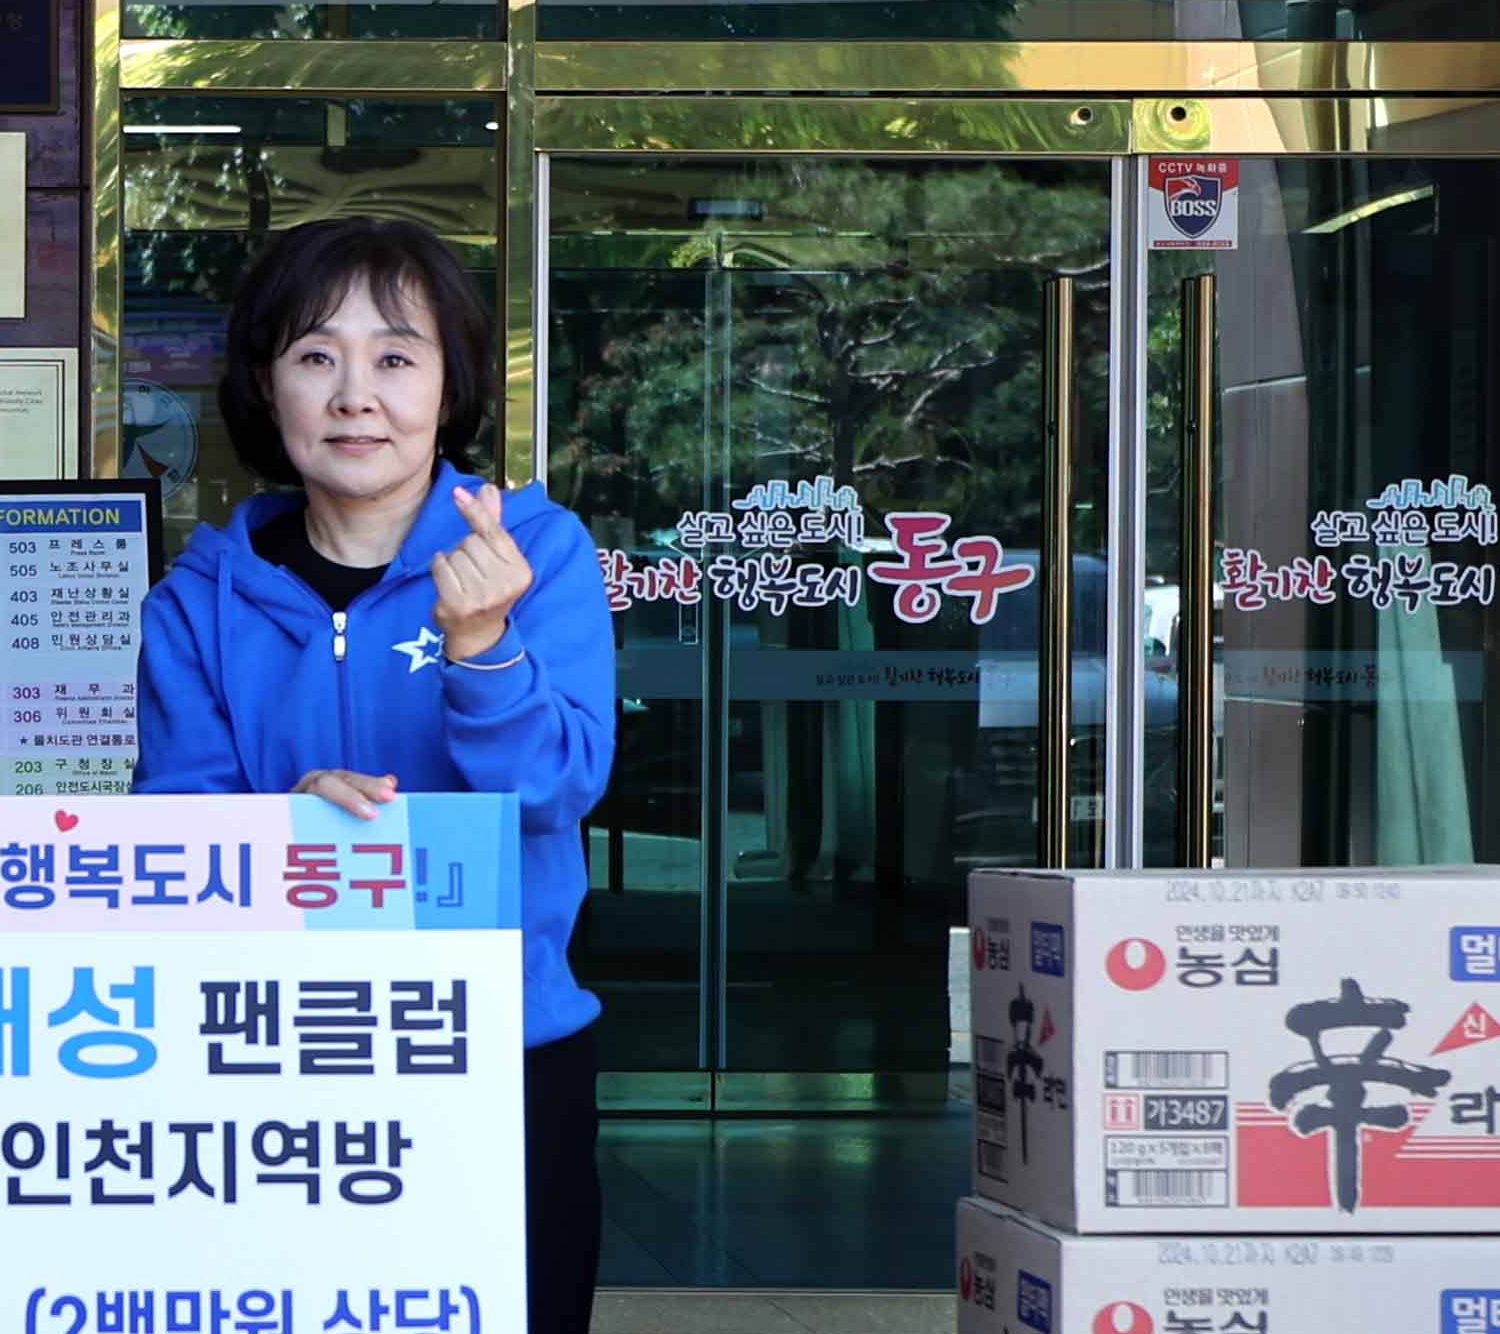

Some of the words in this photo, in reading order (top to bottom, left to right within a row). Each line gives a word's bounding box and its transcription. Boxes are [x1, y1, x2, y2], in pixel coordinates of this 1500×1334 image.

[1158, 163, 1193, 173] CCTV
[1171, 200, 1216, 216] BOSS
[677, 511, 734, 548] 살고
[739, 511, 796, 548] 싶은
[799, 511, 865, 545] 도시!
[1311, 510, 1370, 546] 살고
[1372, 510, 1430, 547] 싶은
[1432, 511, 1498, 545] 도시!
[9, 542, 37, 554] 503
[9, 565, 37, 576] 505
[708, 553, 862, 616] 행복도시
[867, 512, 1035, 624] 동구
[1221, 548, 1336, 611] 활기찬
[1342, 554, 1495, 615] 행복도시
[10, 591, 38, 602] 403
[11, 615, 38, 627] 405
[12, 638, 40, 650] 408
[13, 687, 40, 699] 303
[14, 711, 41, 723] 306
[15, 761, 42, 773] 203
[16, 784, 43, 795] 206
[0, 842, 253, 910] 행복도시
[200, 979, 469, 1076] 팬클럽
[1, 1118, 412, 1206] 인천지역방
